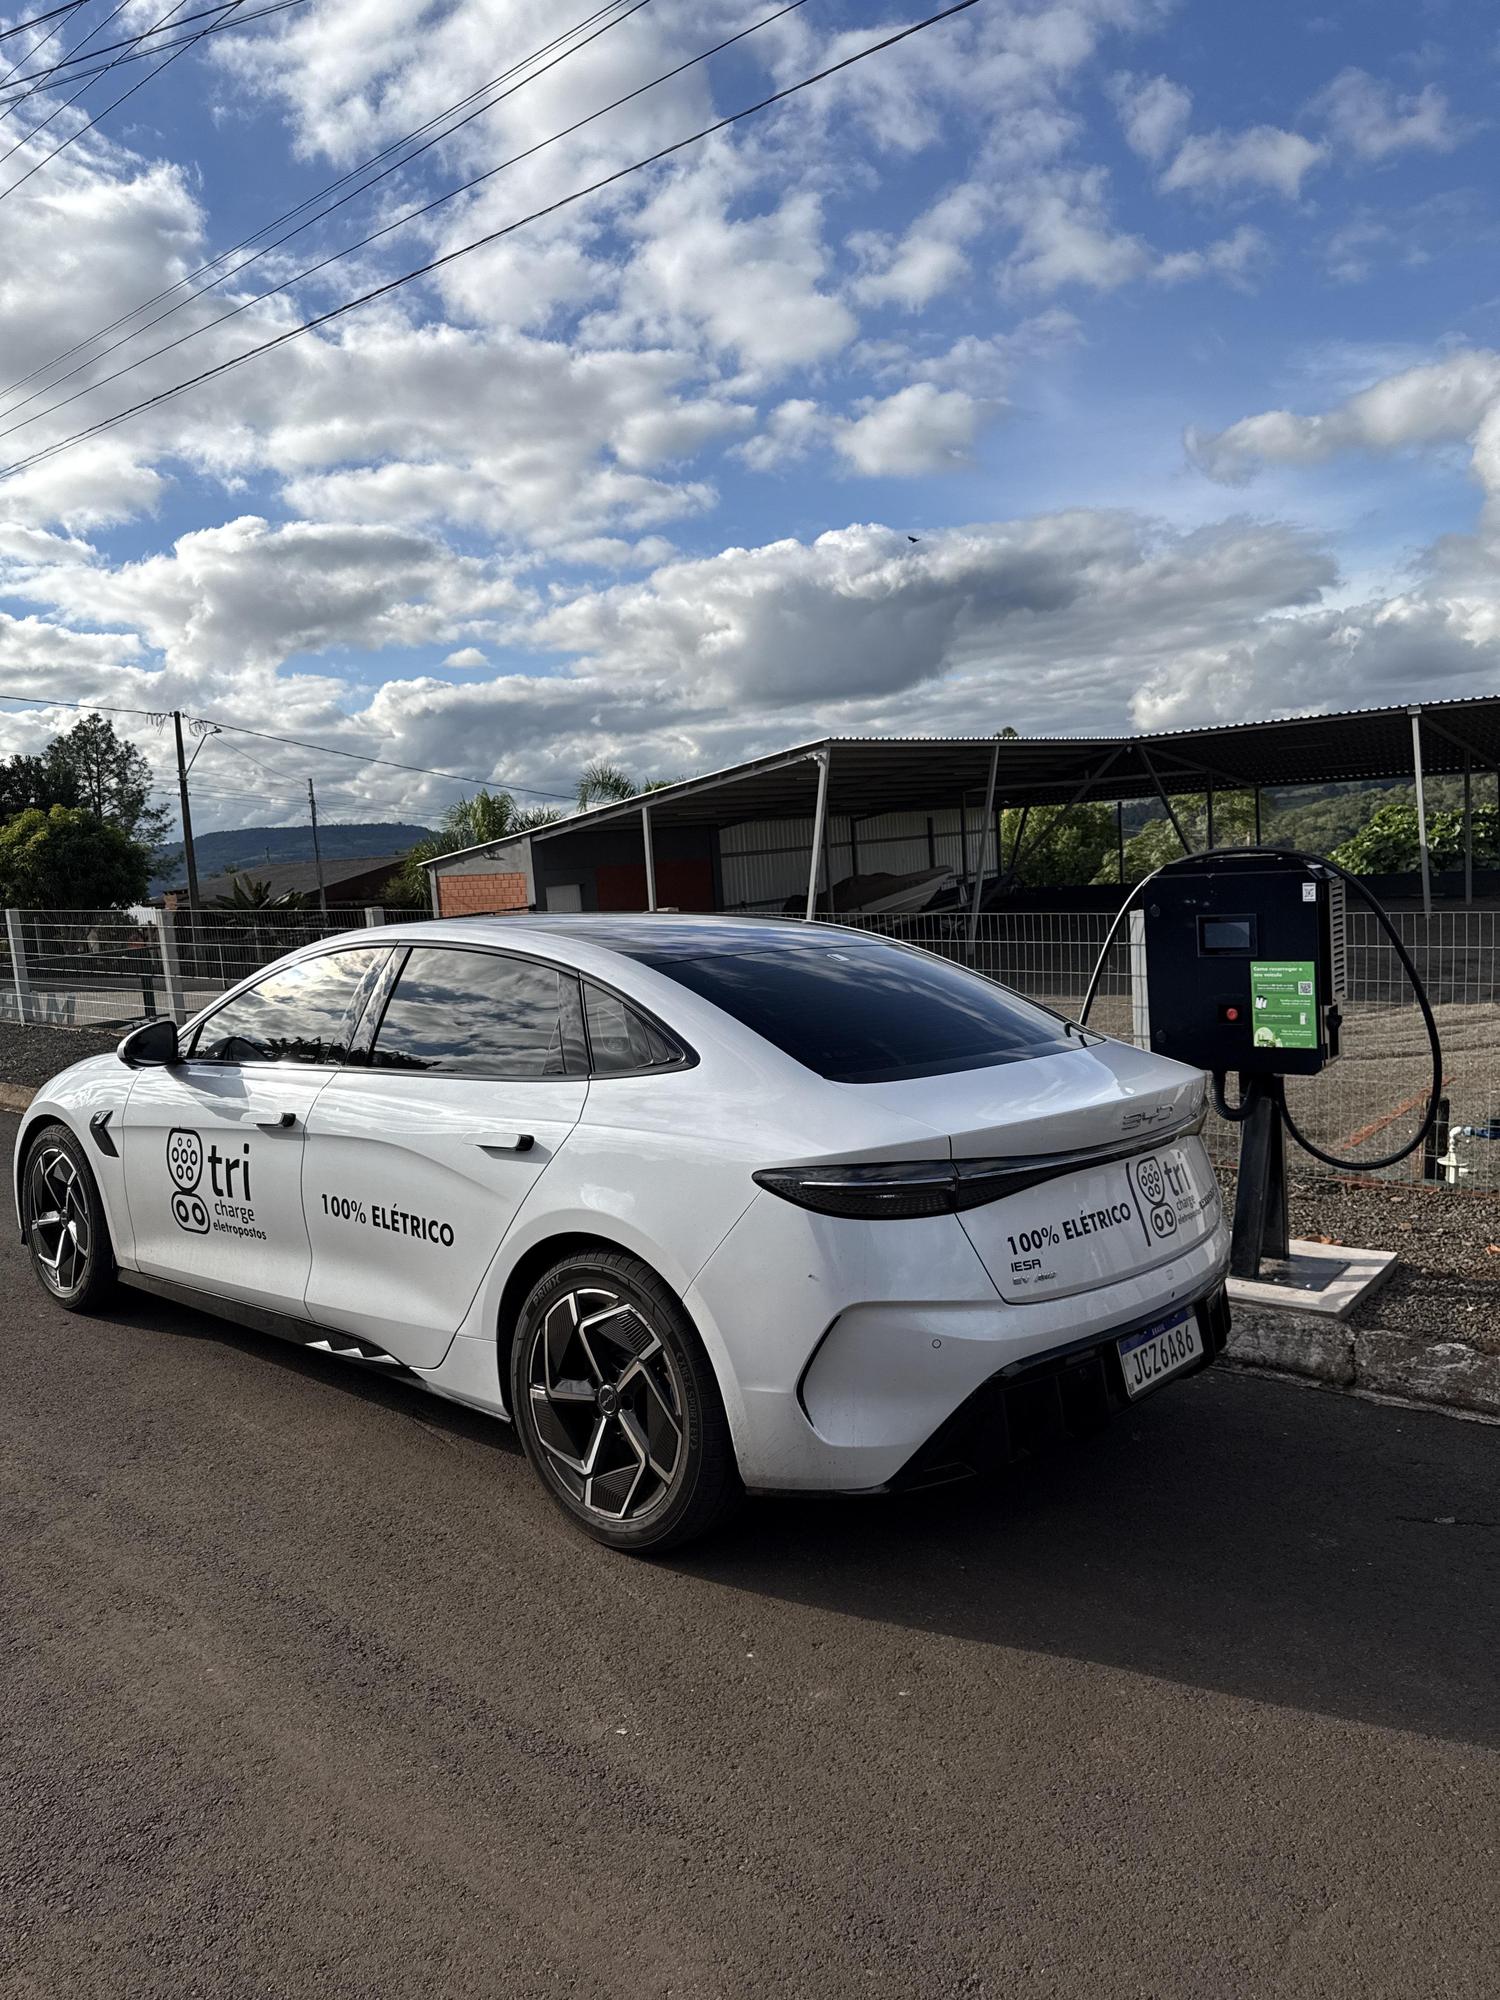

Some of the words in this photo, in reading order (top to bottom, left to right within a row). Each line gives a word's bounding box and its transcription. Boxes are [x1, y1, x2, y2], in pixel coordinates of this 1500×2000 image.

[208, 1143, 251, 1201] tri
[1164, 1151, 1191, 1197] tri
[213, 1219, 267, 1240] eletropostos
[214, 1199, 255, 1224] charge
[322, 1193, 367, 1224] 100%
[372, 1203, 455, 1247] ELÉTRICO
[1007, 1225, 1060, 1255] 100%
[1062, 1203, 1131, 1240] ELÉTRICO
[1011, 1259, 1042, 1273] IESA
[1133, 1325, 1194, 1385] JCZ6A86
